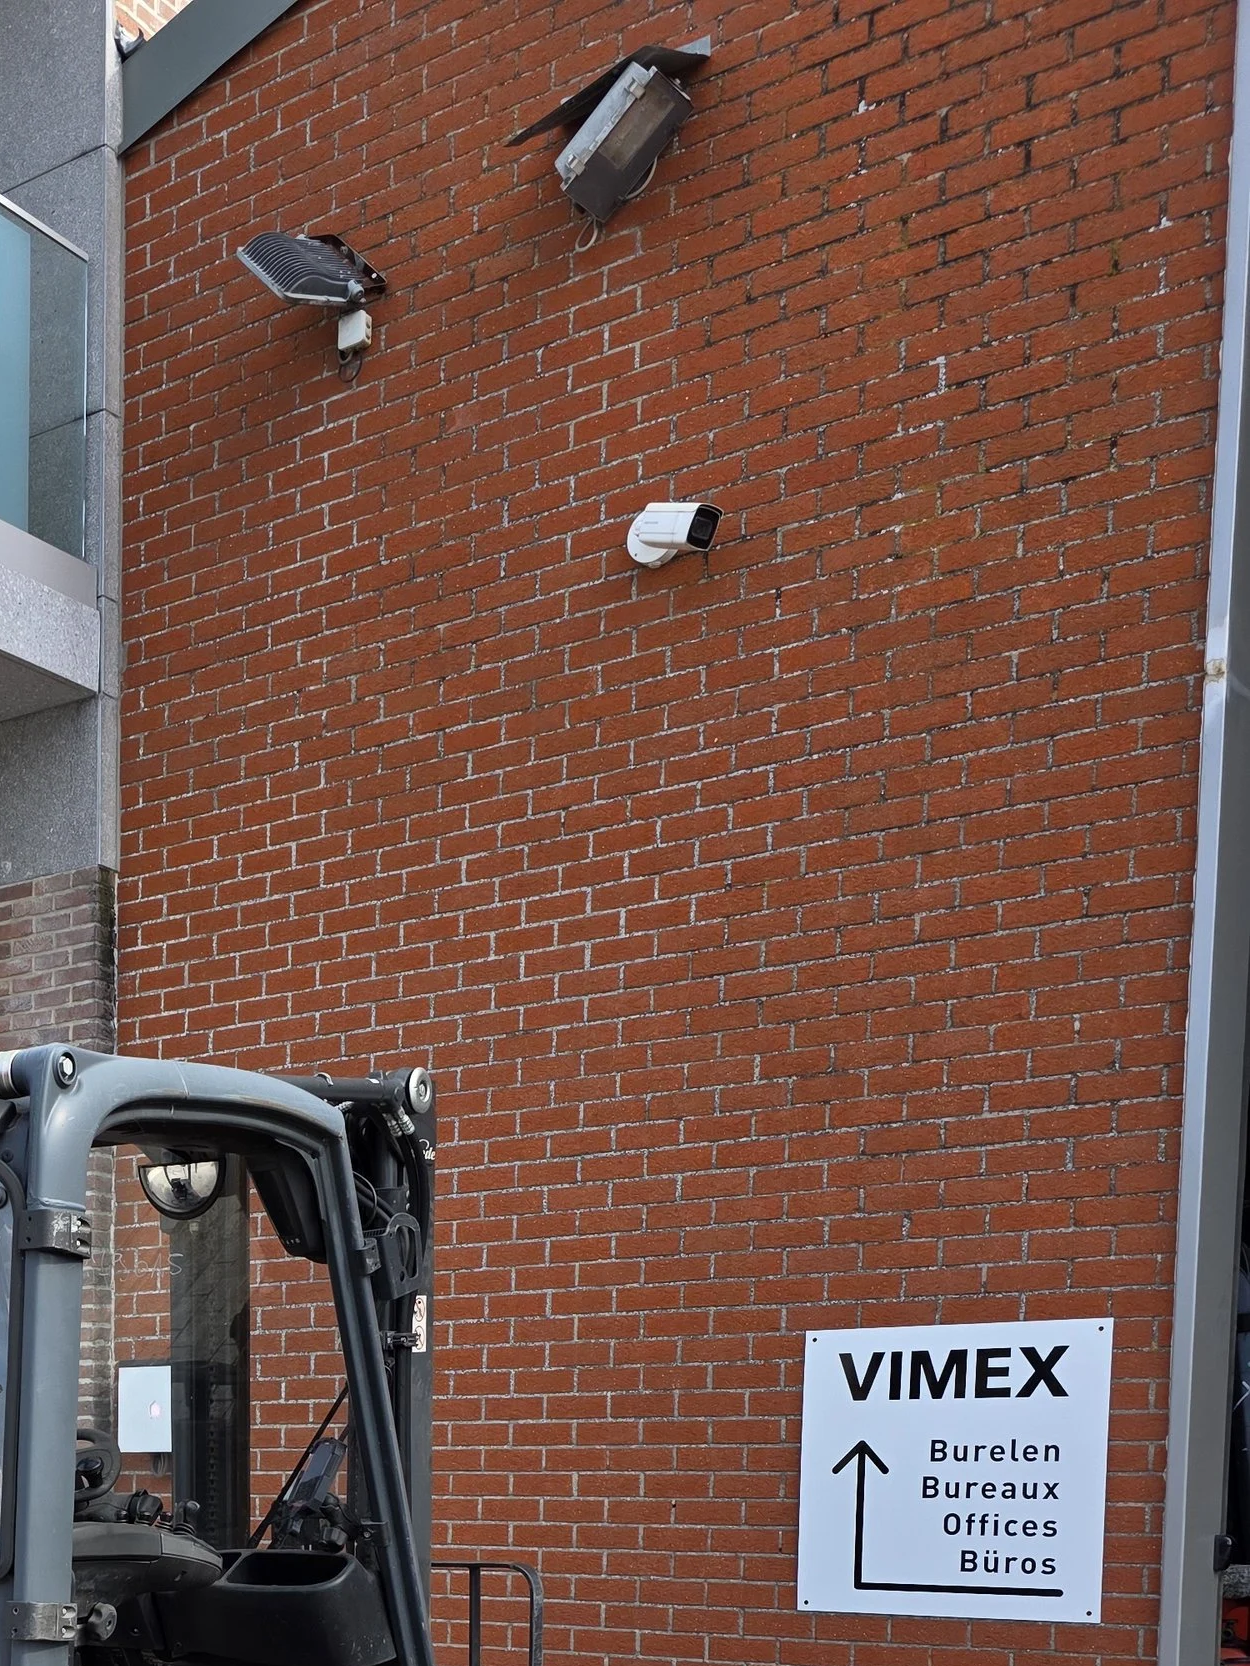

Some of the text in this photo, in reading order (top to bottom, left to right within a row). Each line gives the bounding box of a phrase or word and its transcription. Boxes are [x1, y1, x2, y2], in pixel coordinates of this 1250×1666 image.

[838, 1345, 1070, 1401] VIMEX
[929, 1439, 1061, 1463] Burelen
[921, 1475, 1060, 1500] Bureaux
[942, 1512, 1059, 1537] Offices
[959, 1549, 1057, 1575] Büros
